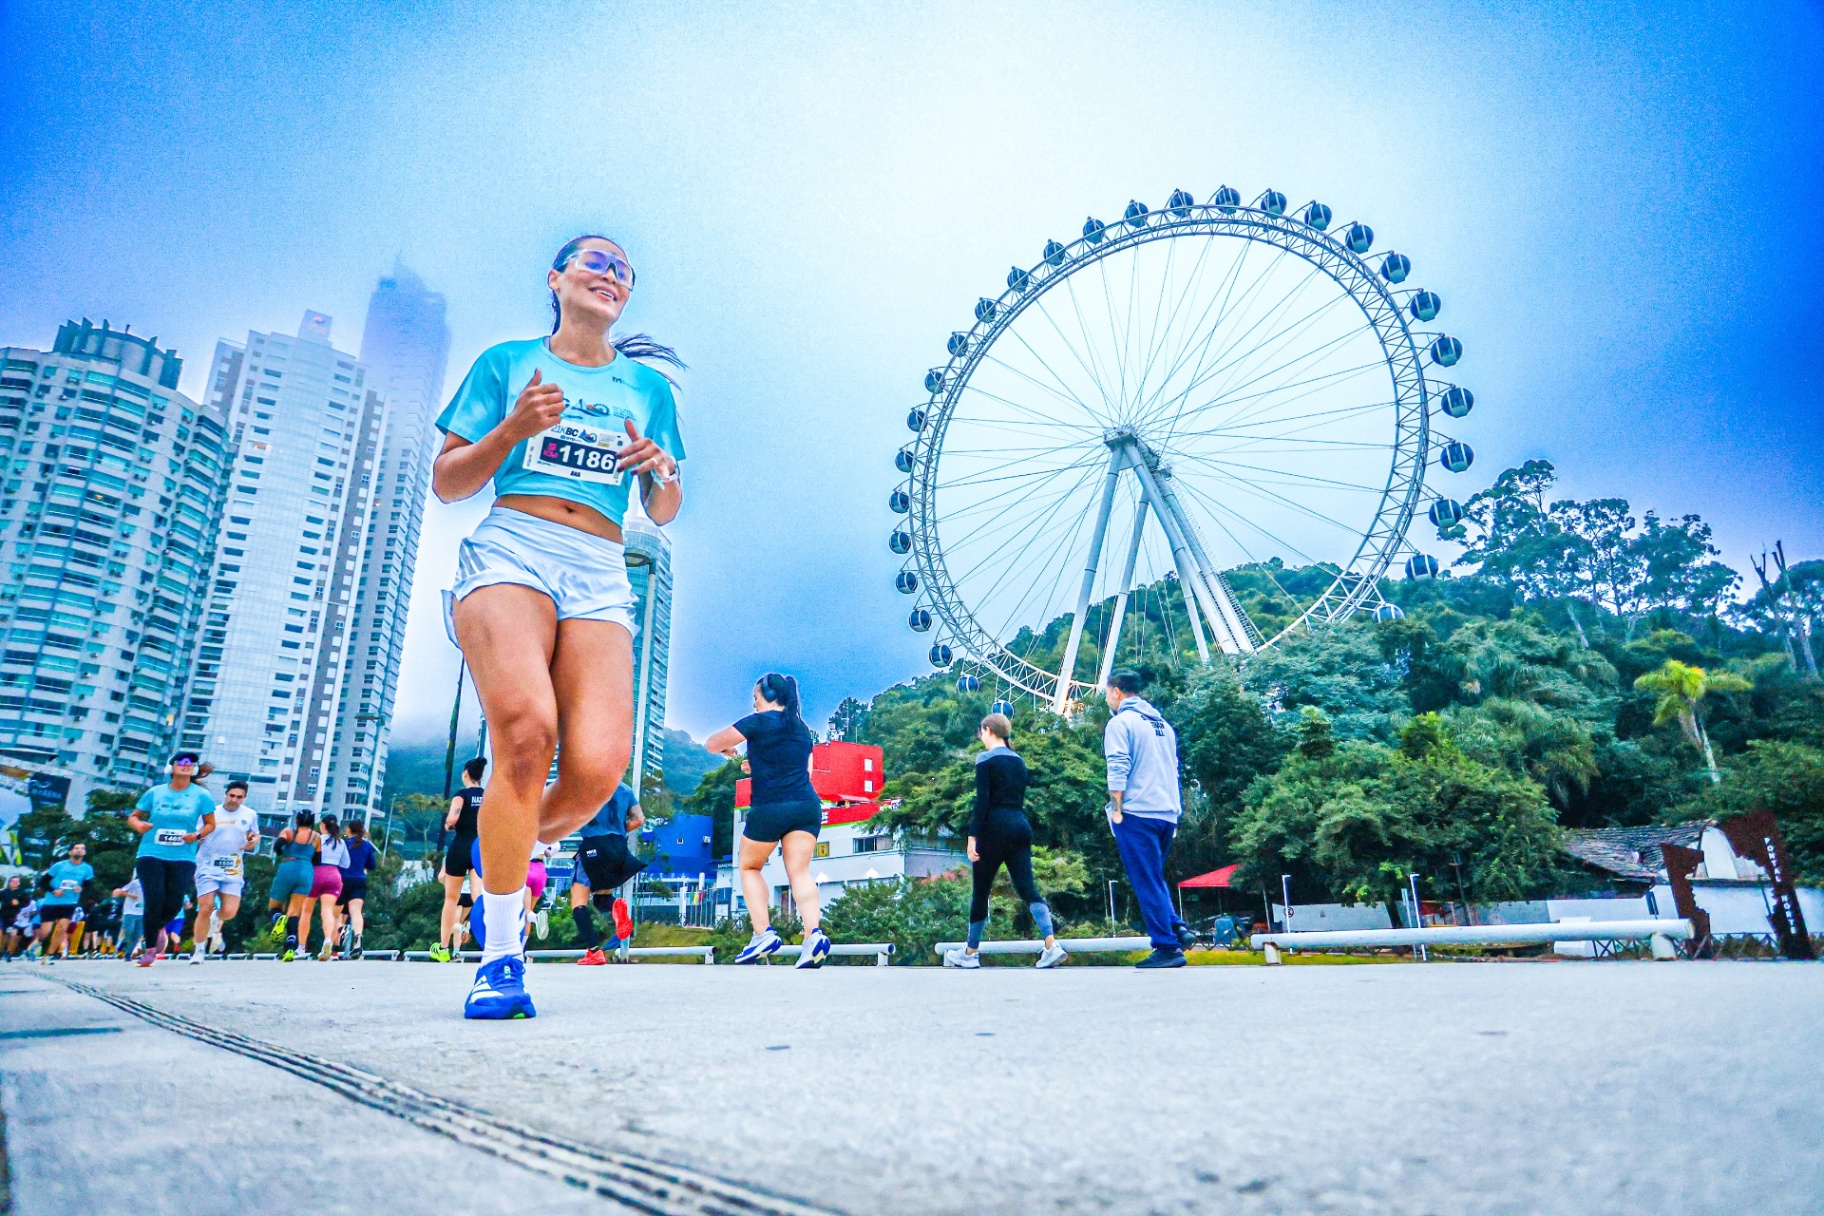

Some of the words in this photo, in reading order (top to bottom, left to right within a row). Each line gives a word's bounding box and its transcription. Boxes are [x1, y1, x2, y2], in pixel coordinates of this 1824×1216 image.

[559, 444, 616, 471] 1186
[1764, 837, 1781, 882] PONTAL
[1781, 895, 1797, 934] NORTE
